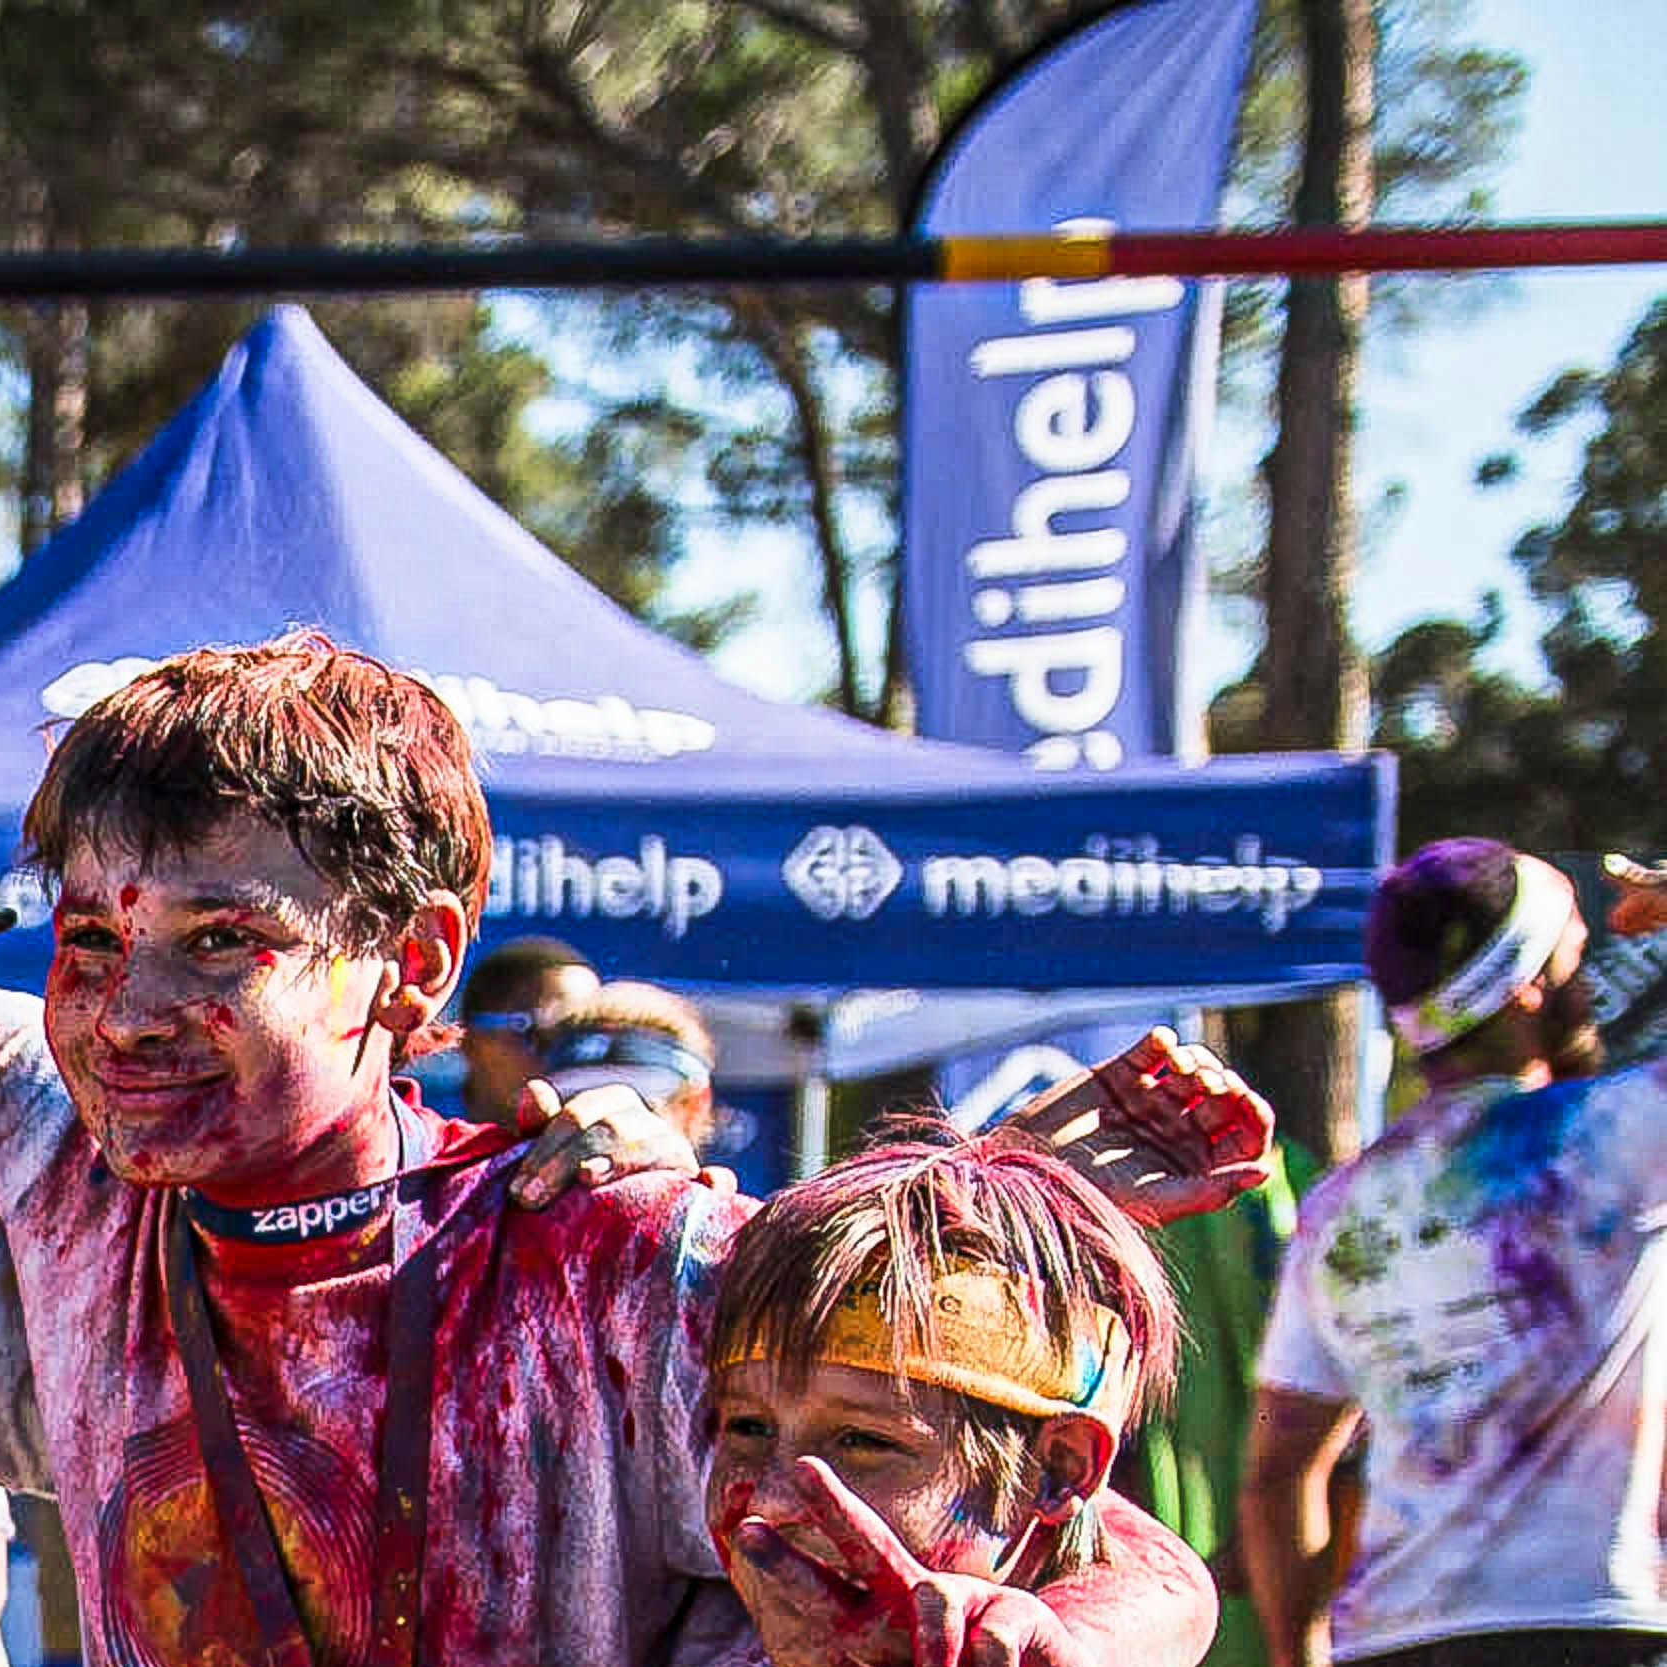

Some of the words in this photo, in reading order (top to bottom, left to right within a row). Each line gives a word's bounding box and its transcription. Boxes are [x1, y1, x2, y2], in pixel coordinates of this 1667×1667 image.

[484, 832, 724, 942] dihelp
[920, 832, 1325, 935] medihelp
[252, 1184, 386, 1239] zapper
